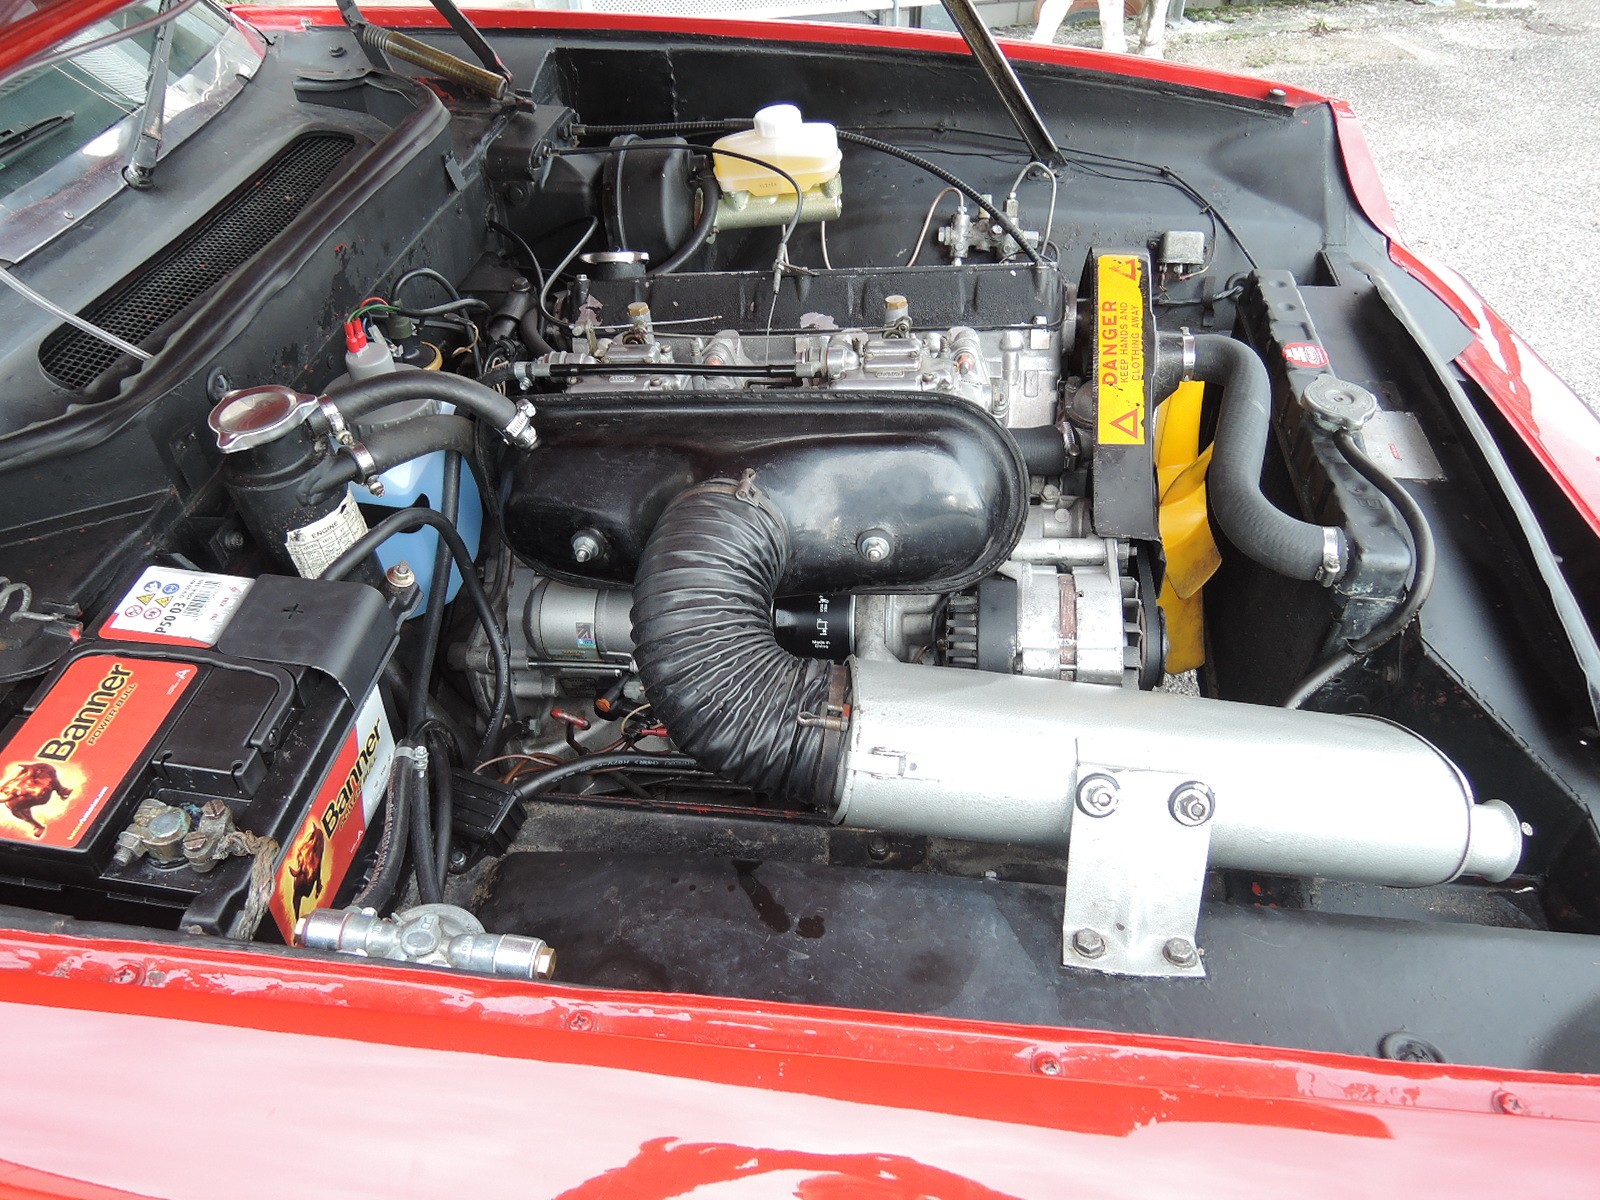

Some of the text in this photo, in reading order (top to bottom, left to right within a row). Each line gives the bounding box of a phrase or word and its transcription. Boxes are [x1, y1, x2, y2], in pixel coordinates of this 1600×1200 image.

[1101, 300, 1118, 386] DANGER
[1119, 301, 1129, 383] KEEP HANDS AND
[1130, 304, 1141, 382] CLOTHING AWAY
[311, 520, 339, 539] ENGINE
[154, 602, 186, 634] P50 03
[36, 663, 133, 762] Banner
[87, 683, 138, 746] POWER BULL
[321, 717, 381, 840] Banner
